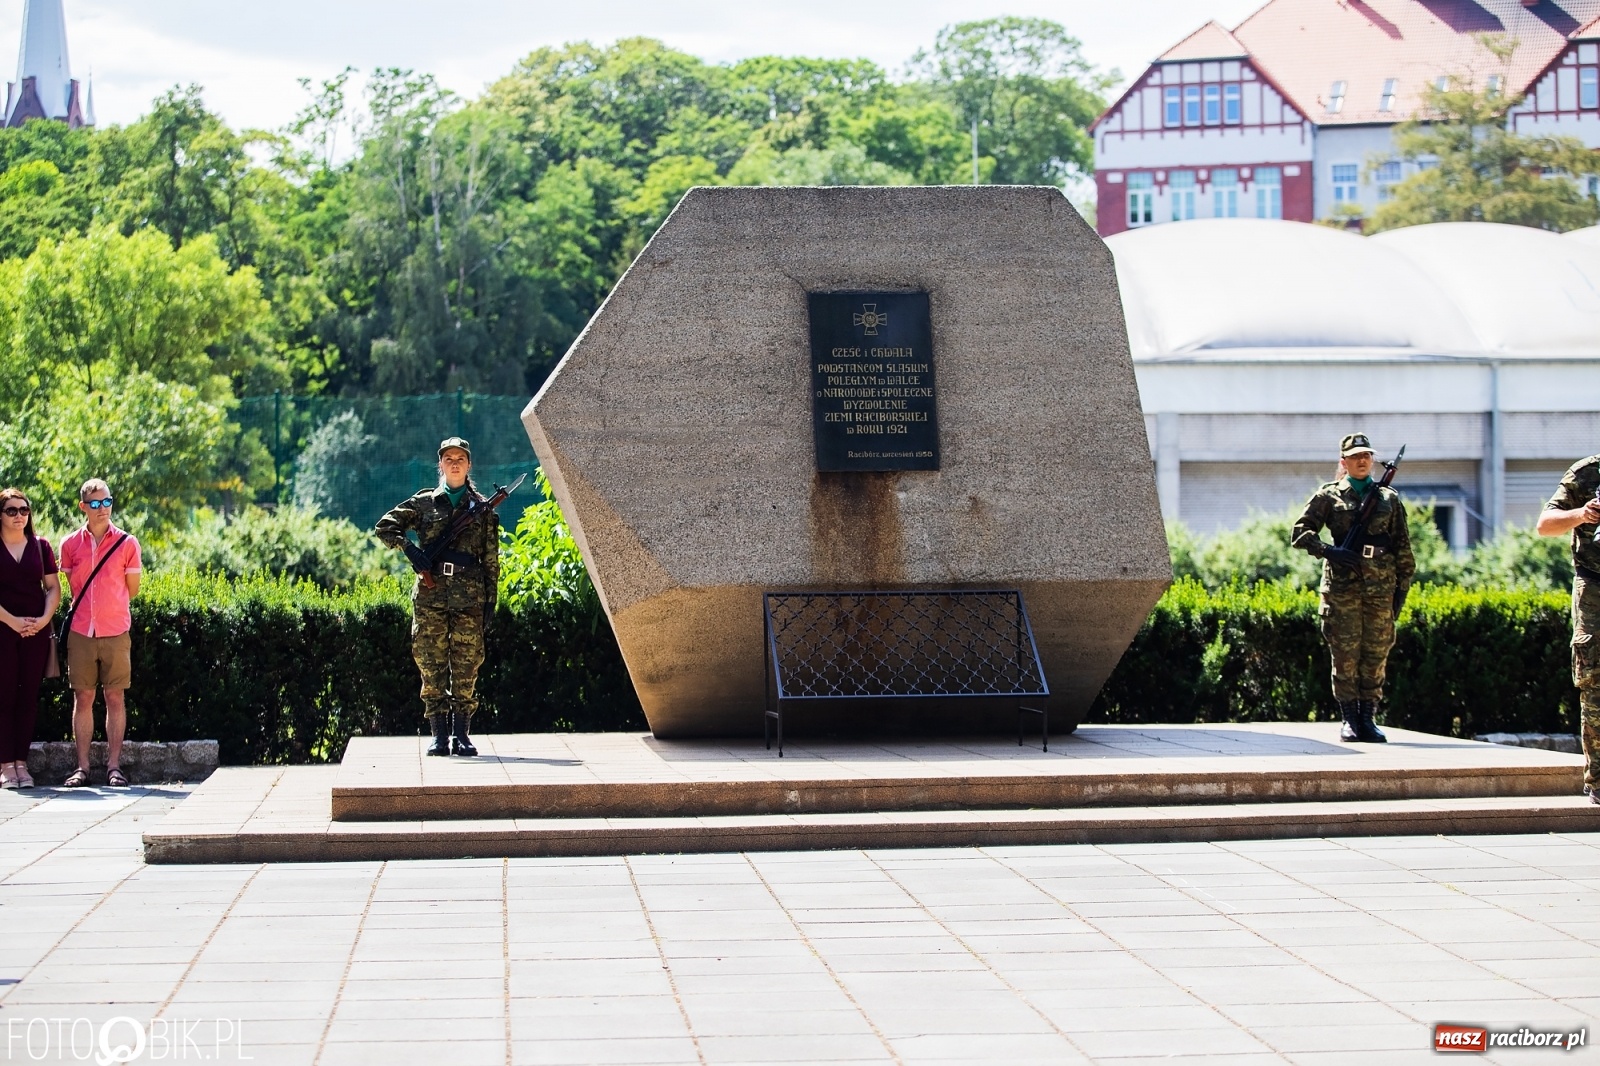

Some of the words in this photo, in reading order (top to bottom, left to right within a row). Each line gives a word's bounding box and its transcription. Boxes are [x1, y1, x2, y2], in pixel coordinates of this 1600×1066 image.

[887, 375, 920, 385] WALCE
[823, 387, 877, 398] NARODOWE
[843, 400, 908, 410] WYZWOLENIE
[824, 412, 853, 422] ZIEMI
[855, 411, 928, 422] RACIBORSKIEJ
[856, 424, 884, 434] ROKU
[886, 424, 908, 434] 1921
